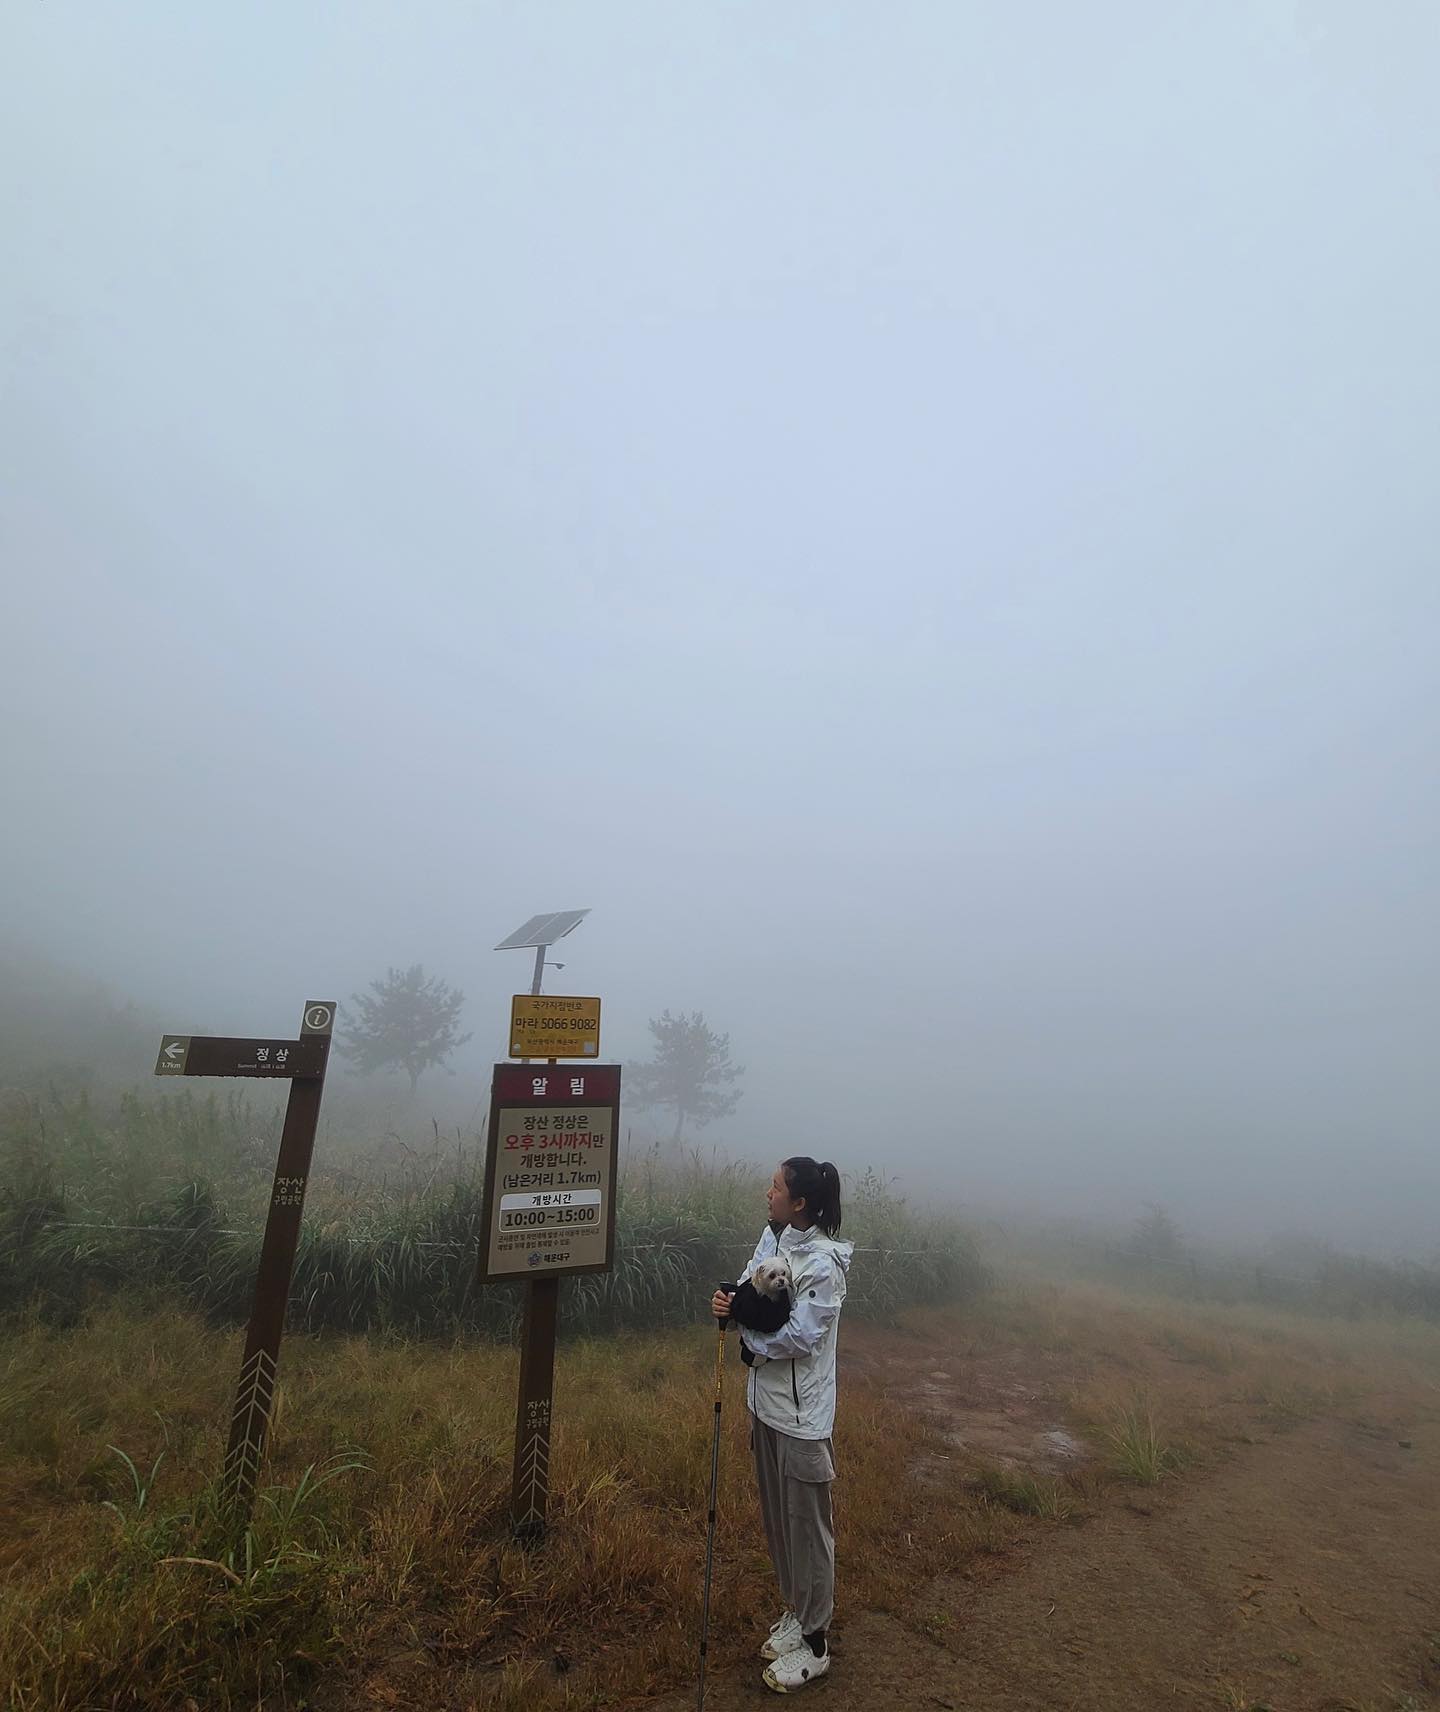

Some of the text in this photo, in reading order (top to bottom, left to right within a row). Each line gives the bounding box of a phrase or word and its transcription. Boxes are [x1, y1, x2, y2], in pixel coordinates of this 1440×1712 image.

[515, 1017, 597, 1030] 마라 5066 9082
[523, 1114, 589, 1131] 장산 정상은
[504, 1131, 604, 1151] 오후 3시까지만
[520, 1152, 587, 1169] 개방합니다.
[503, 1170, 601, 1189] (남은거리 1.7km)
[531, 1193, 572, 1206] 개방시간
[504, 1207, 595, 1227] 10:00~15:00
